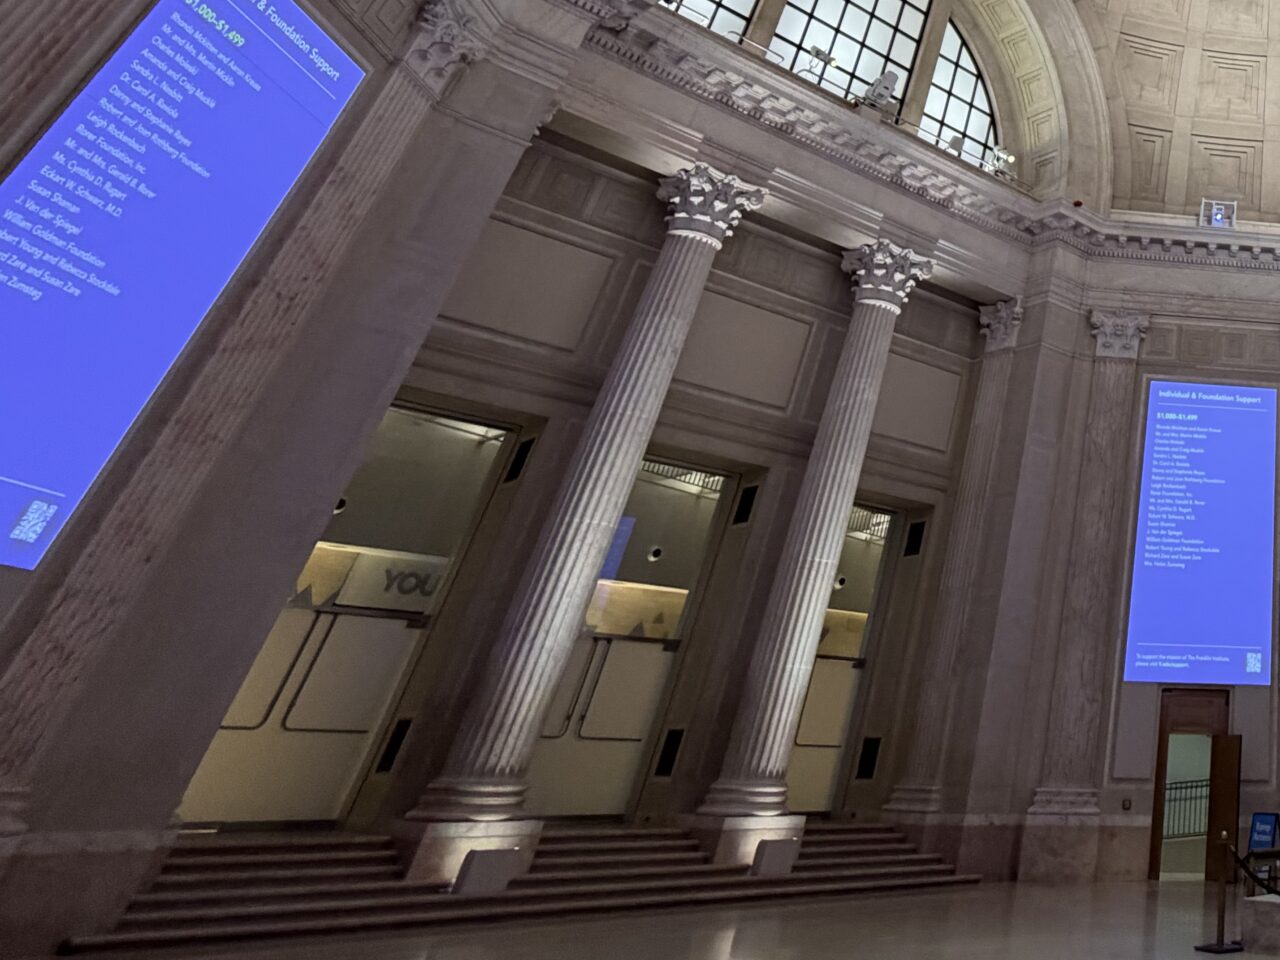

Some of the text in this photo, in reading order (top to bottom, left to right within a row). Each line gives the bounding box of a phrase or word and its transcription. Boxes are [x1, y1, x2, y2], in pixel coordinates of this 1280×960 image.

[151, 35, 175, 58] Charles
[161, 23, 173, 34] Mr.
[171, 33, 187, 46] and
[183, 41, 197, 57] Mrs.
[196, 52, 217, 72] Martin
[170, 11, 195, 35] Rhonda
[216, 52, 231, 64] and
[227, 60, 245, 77] Aaron
[264, 5, 310, 53] Foundation
[308, 47, 340, 81] Support
[119, 71, 132, 85] Dr.
[130, 79, 151, 97] Carol
[130, 59, 154, 81] Sandra
[140, 47, 168, 71] Amanda
[165, 68, 182, 81] and
[178, 76, 196, 95] Craig
[85, 110, 108, 128] Leigh
[108, 83, 192, 147] Danny and Stephanie Reyes
[95, 135, 134, 168] Foundation,
[134, 161, 146, 175] Inc.
[98, 96, 124, 118] Robert
[121, 114, 138, 127] and
[133, 123, 152, 137] Joan
[177, 151, 210, 178] Foundation
[51, 150, 66, 166] Ms.
[66, 159, 95, 182] Cynthia
[63, 136, 77, 150] Mr.
[76, 147, 95, 160] and
[90, 153, 106, 169] Mrs.
[107, 164, 133, 184] Gerald
[26, 179, 52, 198] Susan
[24, 198, 41, 213] Van
[38, 207, 55, 220] der
[52, 213, 83, 235] Spiegel
[103, 202, 123, 217] M.D.
[2, 208, 106, 268] William Goldman Foundation
[18, 237, 44, 260] Young
[41, 252, 60, 265] and
[56, 257, 88, 280] Rebecca
[5, 254, 27, 271] Zare
[25, 265, 45, 278] and
[40, 270, 65, 288] Susan
[62, 280, 81, 297] Zare
[1158, 390, 1190, 399] Individual
[1197, 392, 1235, 401] Foundation
[1235, 394, 1261, 404] Support
